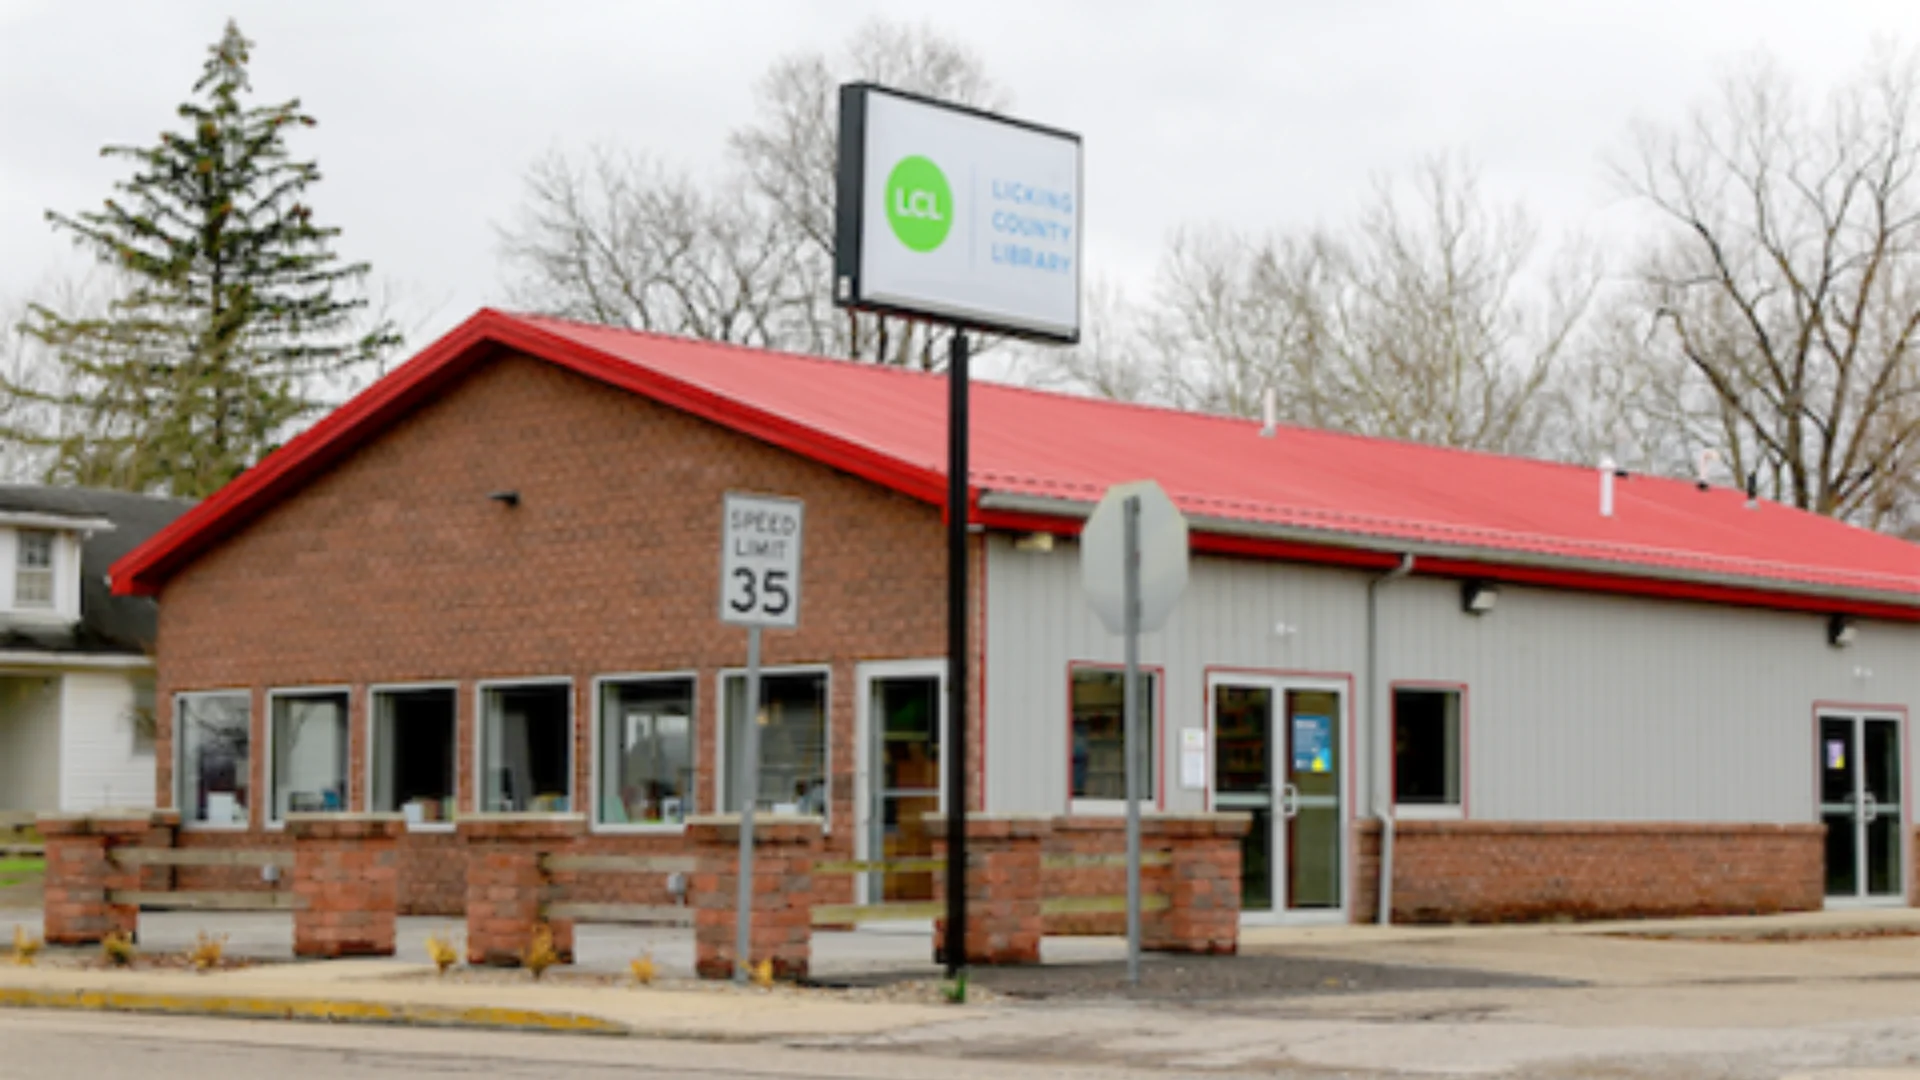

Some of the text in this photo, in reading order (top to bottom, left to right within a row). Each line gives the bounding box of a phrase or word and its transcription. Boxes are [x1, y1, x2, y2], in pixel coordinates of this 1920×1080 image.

[895, 186, 944, 221] LCL
[991, 180, 1073, 214] LICKING
[991, 211, 1072, 242] COUNTY
[991, 243, 1072, 275] LIBRARY
[731, 509, 797, 537] SPEED
[735, 537, 787, 559] LIMIT
[730, 565, 790, 616] 35
